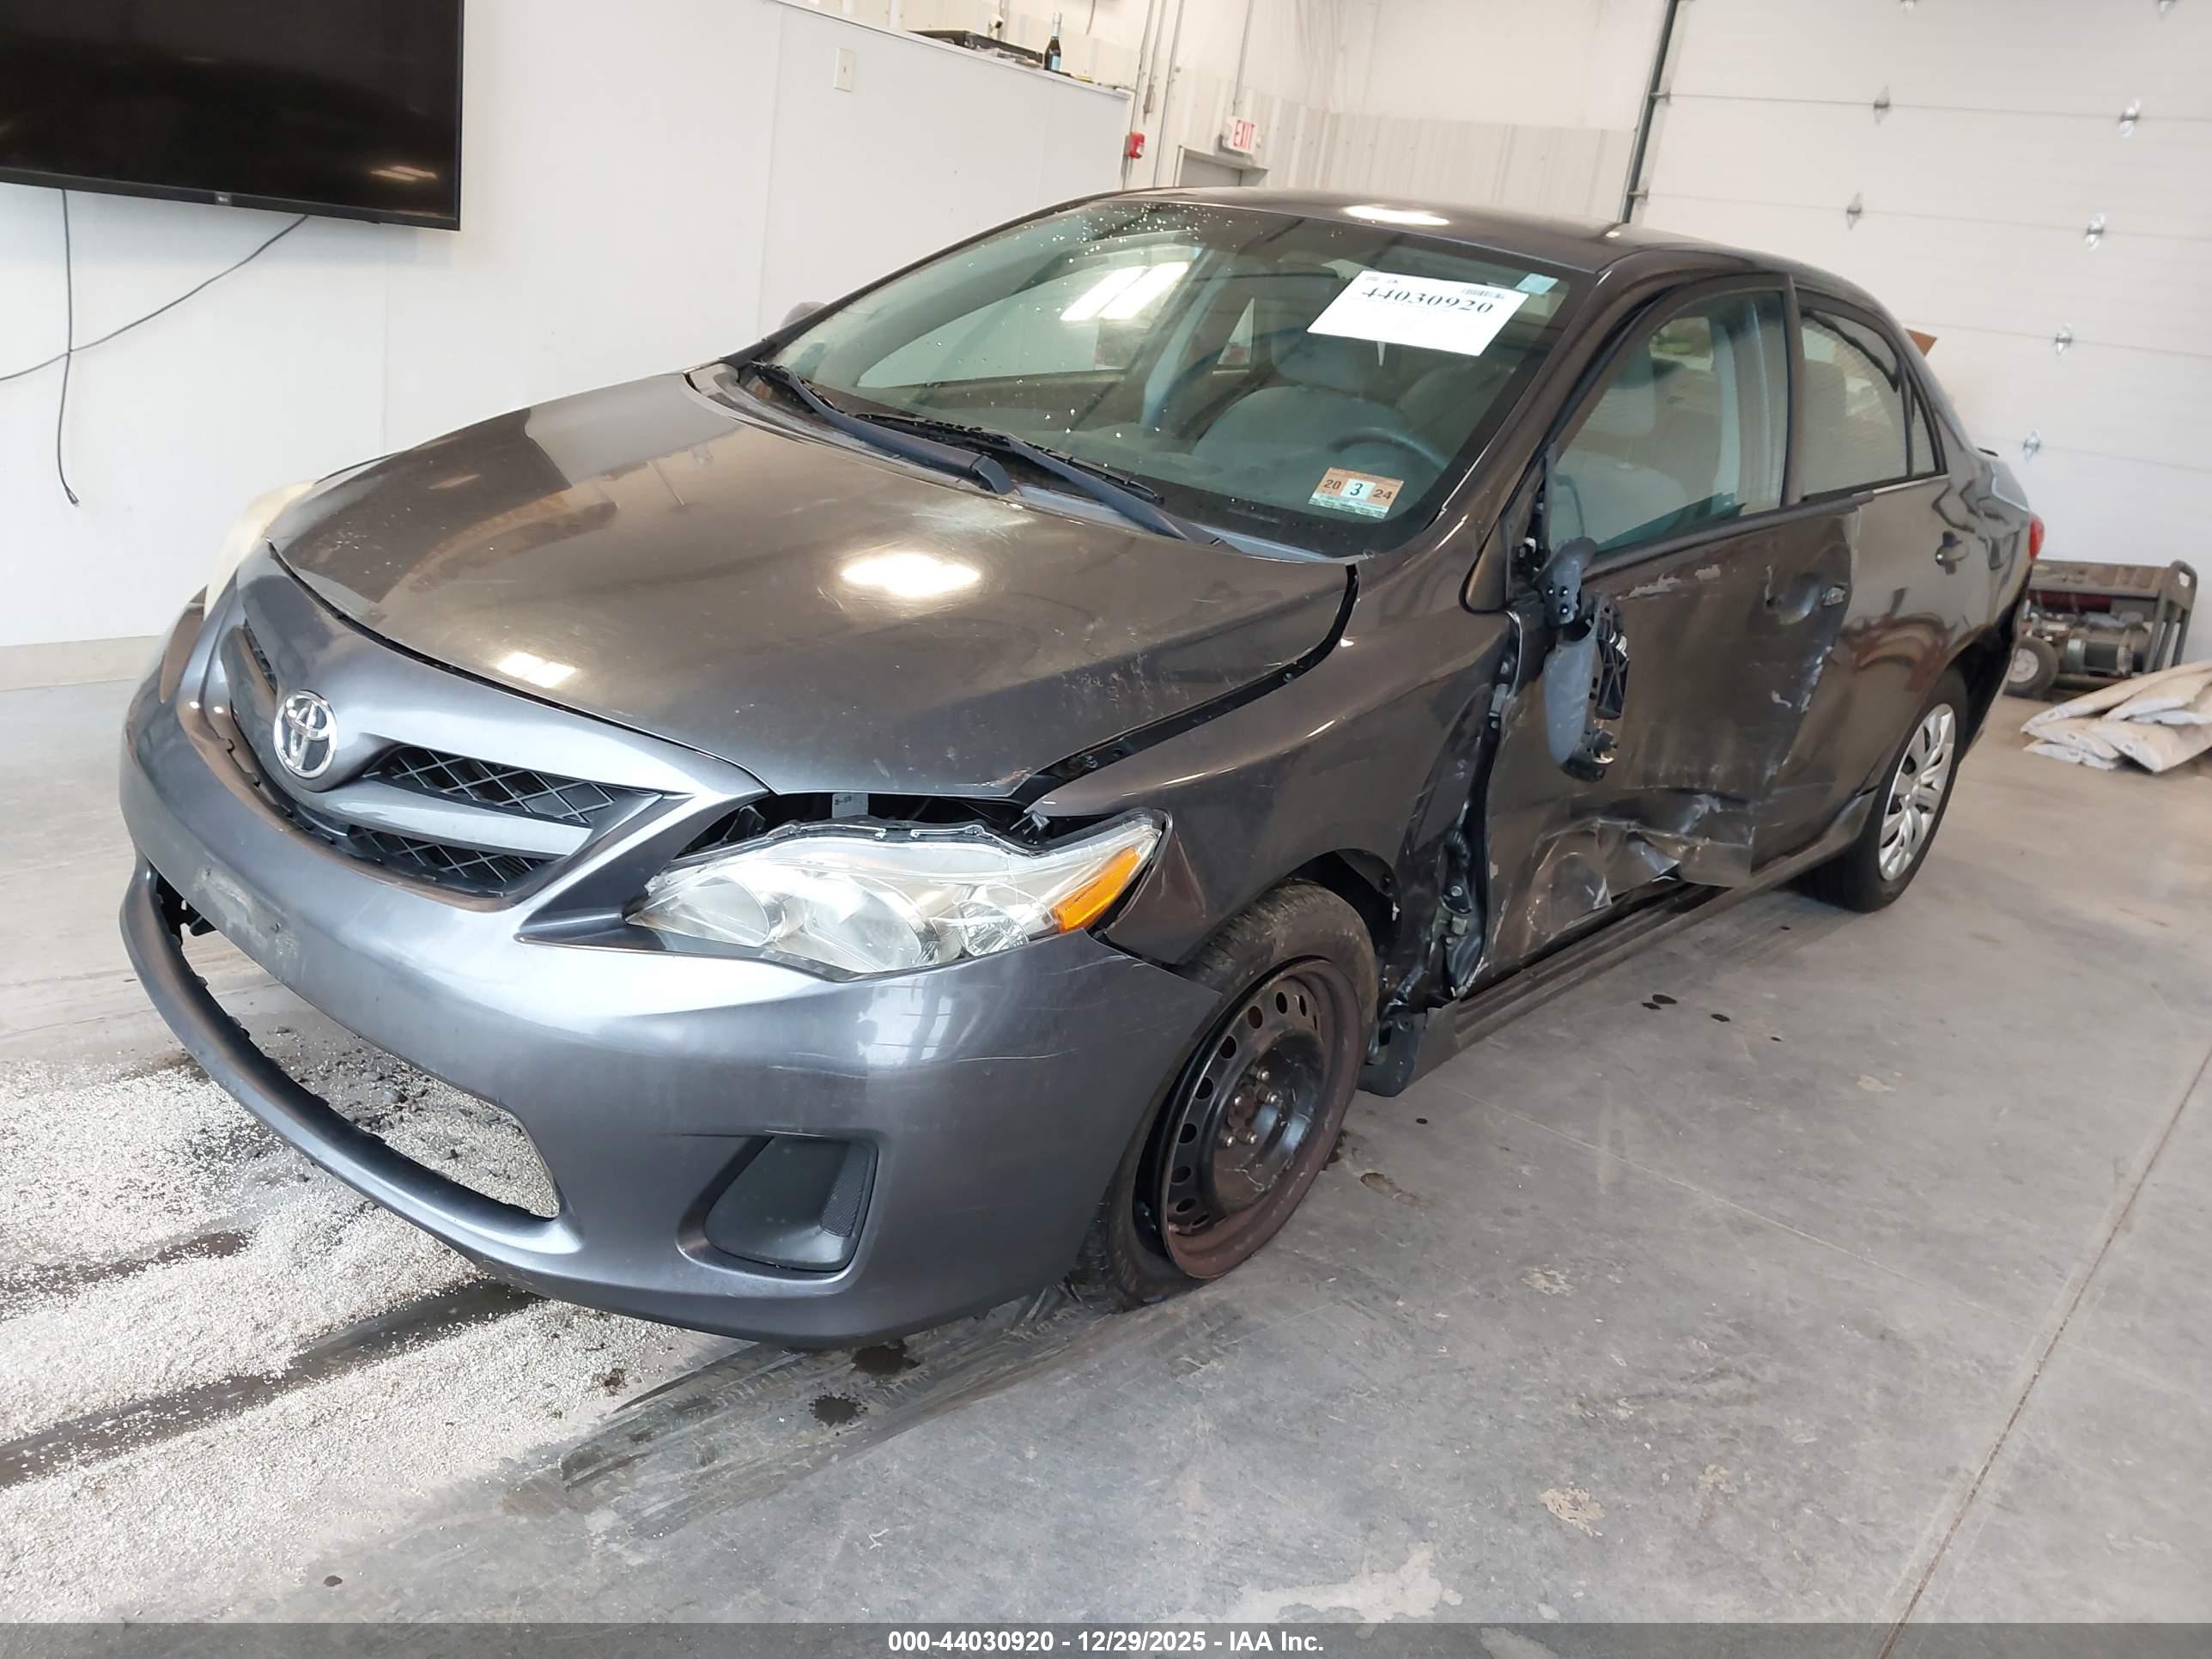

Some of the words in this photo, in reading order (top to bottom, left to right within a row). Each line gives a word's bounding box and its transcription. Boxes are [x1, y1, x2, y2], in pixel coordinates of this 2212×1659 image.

[1233, 119, 1255, 151] EXIT
[1362, 287, 1494, 314] 44030920
[1323, 479, 1341, 490] 20
[1349, 483, 1364, 496] 3
[1373, 489, 1393, 500] 24
